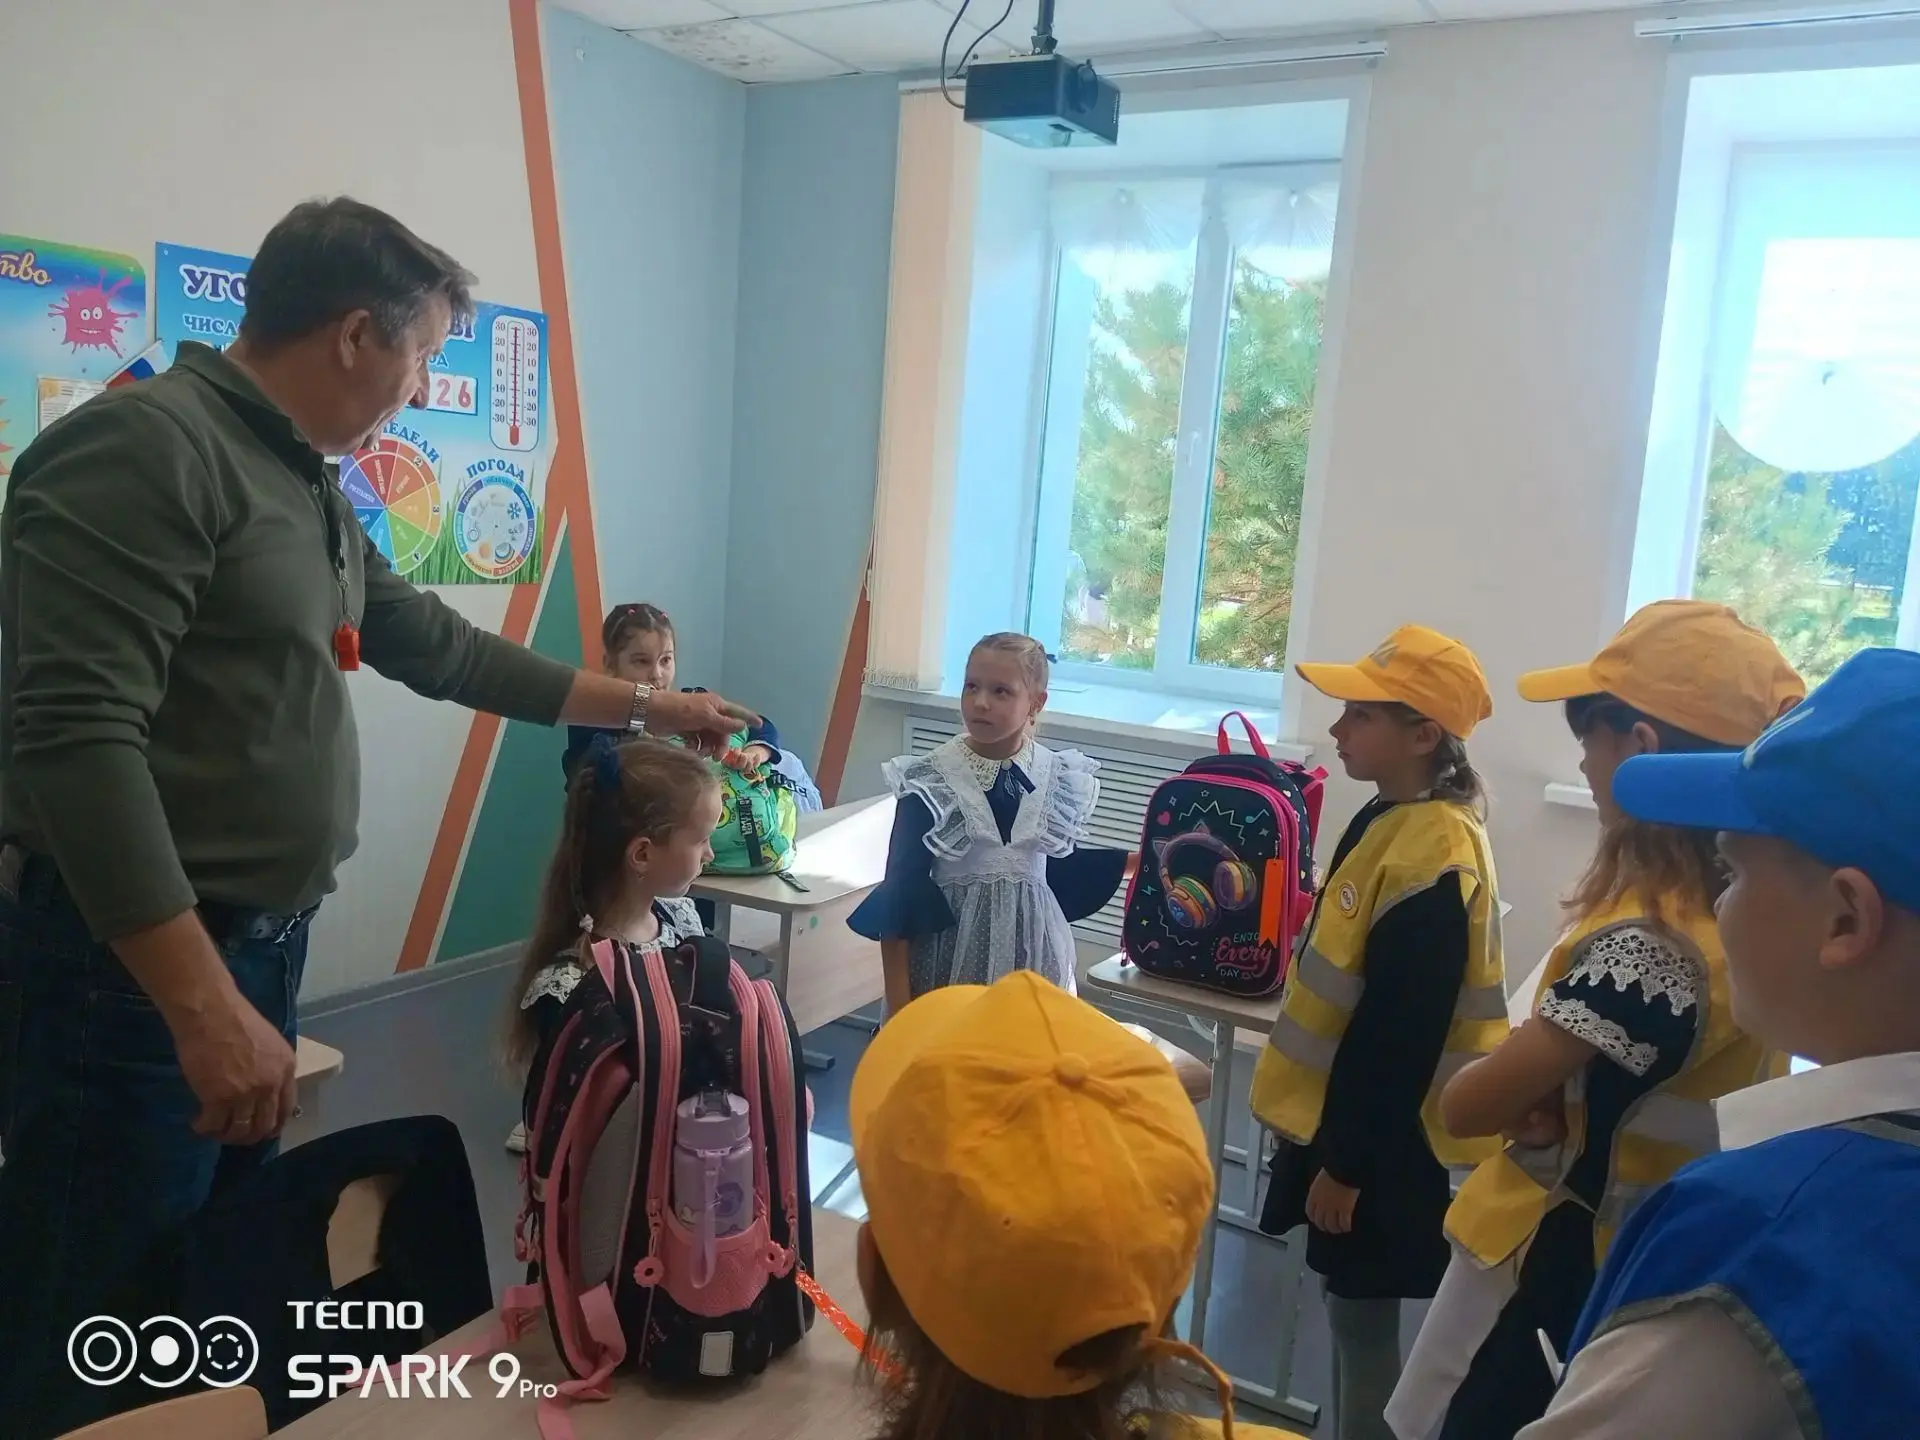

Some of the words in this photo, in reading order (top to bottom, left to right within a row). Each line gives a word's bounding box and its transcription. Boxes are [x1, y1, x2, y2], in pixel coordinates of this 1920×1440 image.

[182, 267, 247, 303] УГО
[183, 314, 239, 336] ЧИСЛ
[466, 458, 525, 482] ПОГОДА
[1216, 937, 1272, 978] Every
[1220, 968, 1240, 978] DAY
